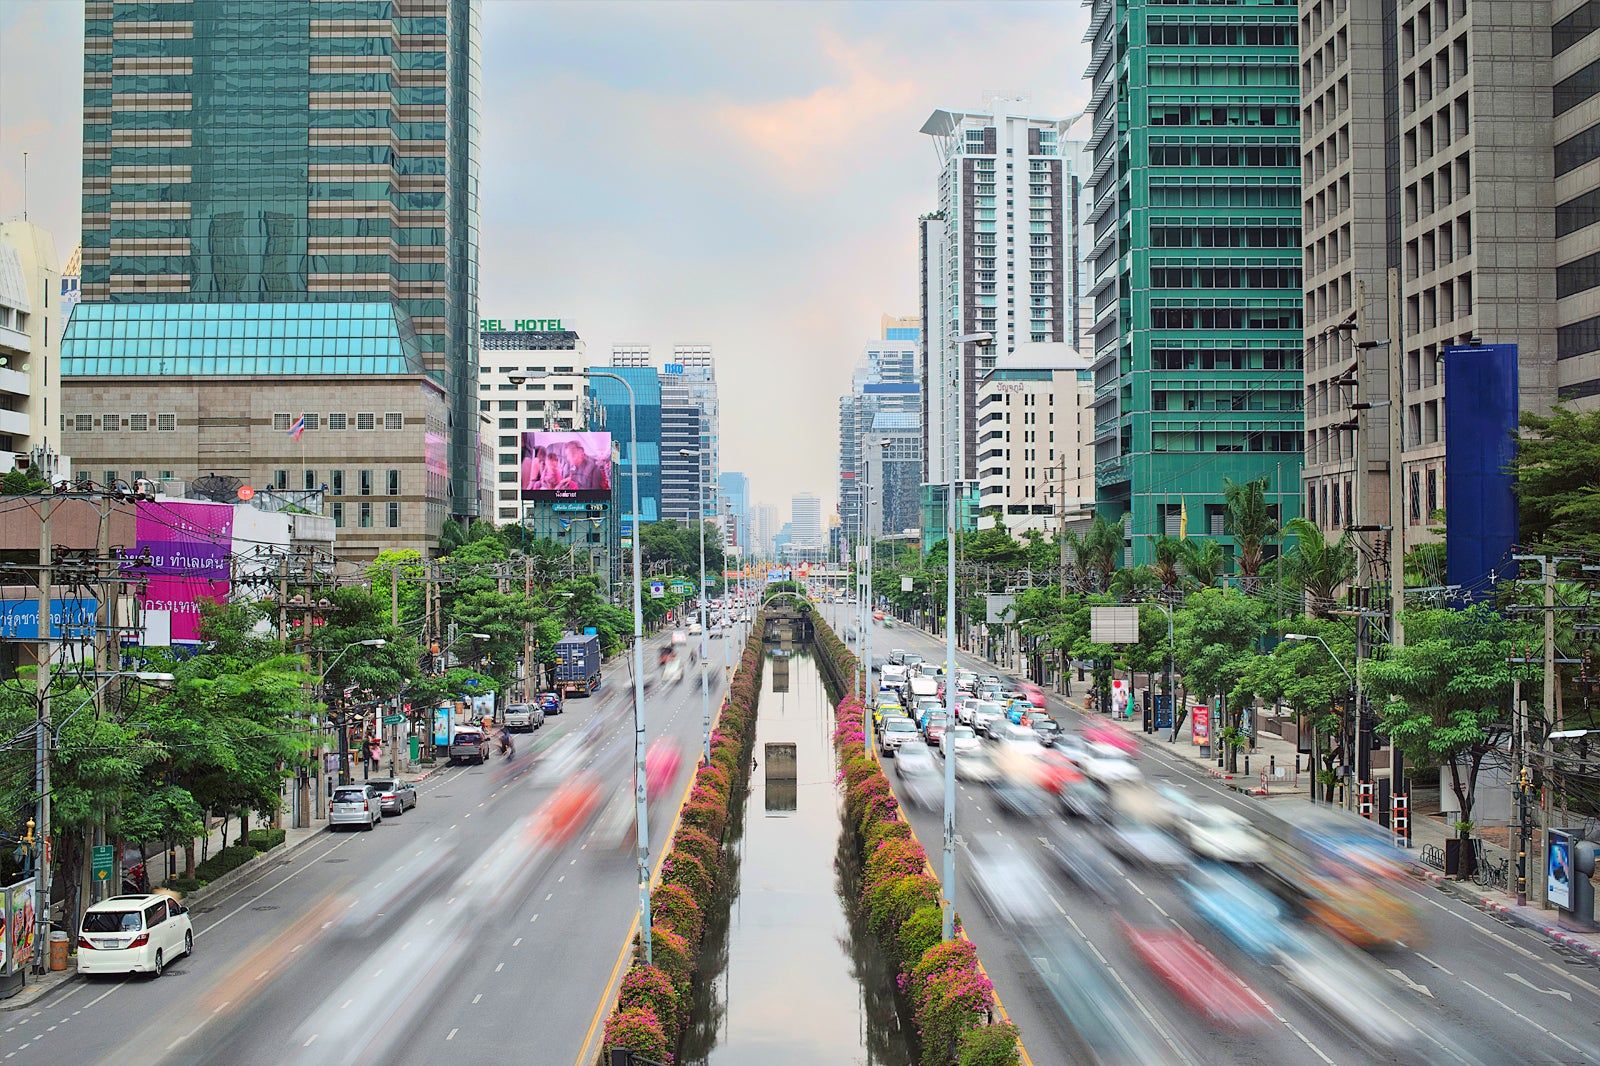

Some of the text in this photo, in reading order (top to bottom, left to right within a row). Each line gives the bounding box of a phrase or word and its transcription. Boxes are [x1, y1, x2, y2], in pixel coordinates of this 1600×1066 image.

[515, 319, 566, 331] HOTEL
[169, 551, 224, 570] ทำเลเด่น
